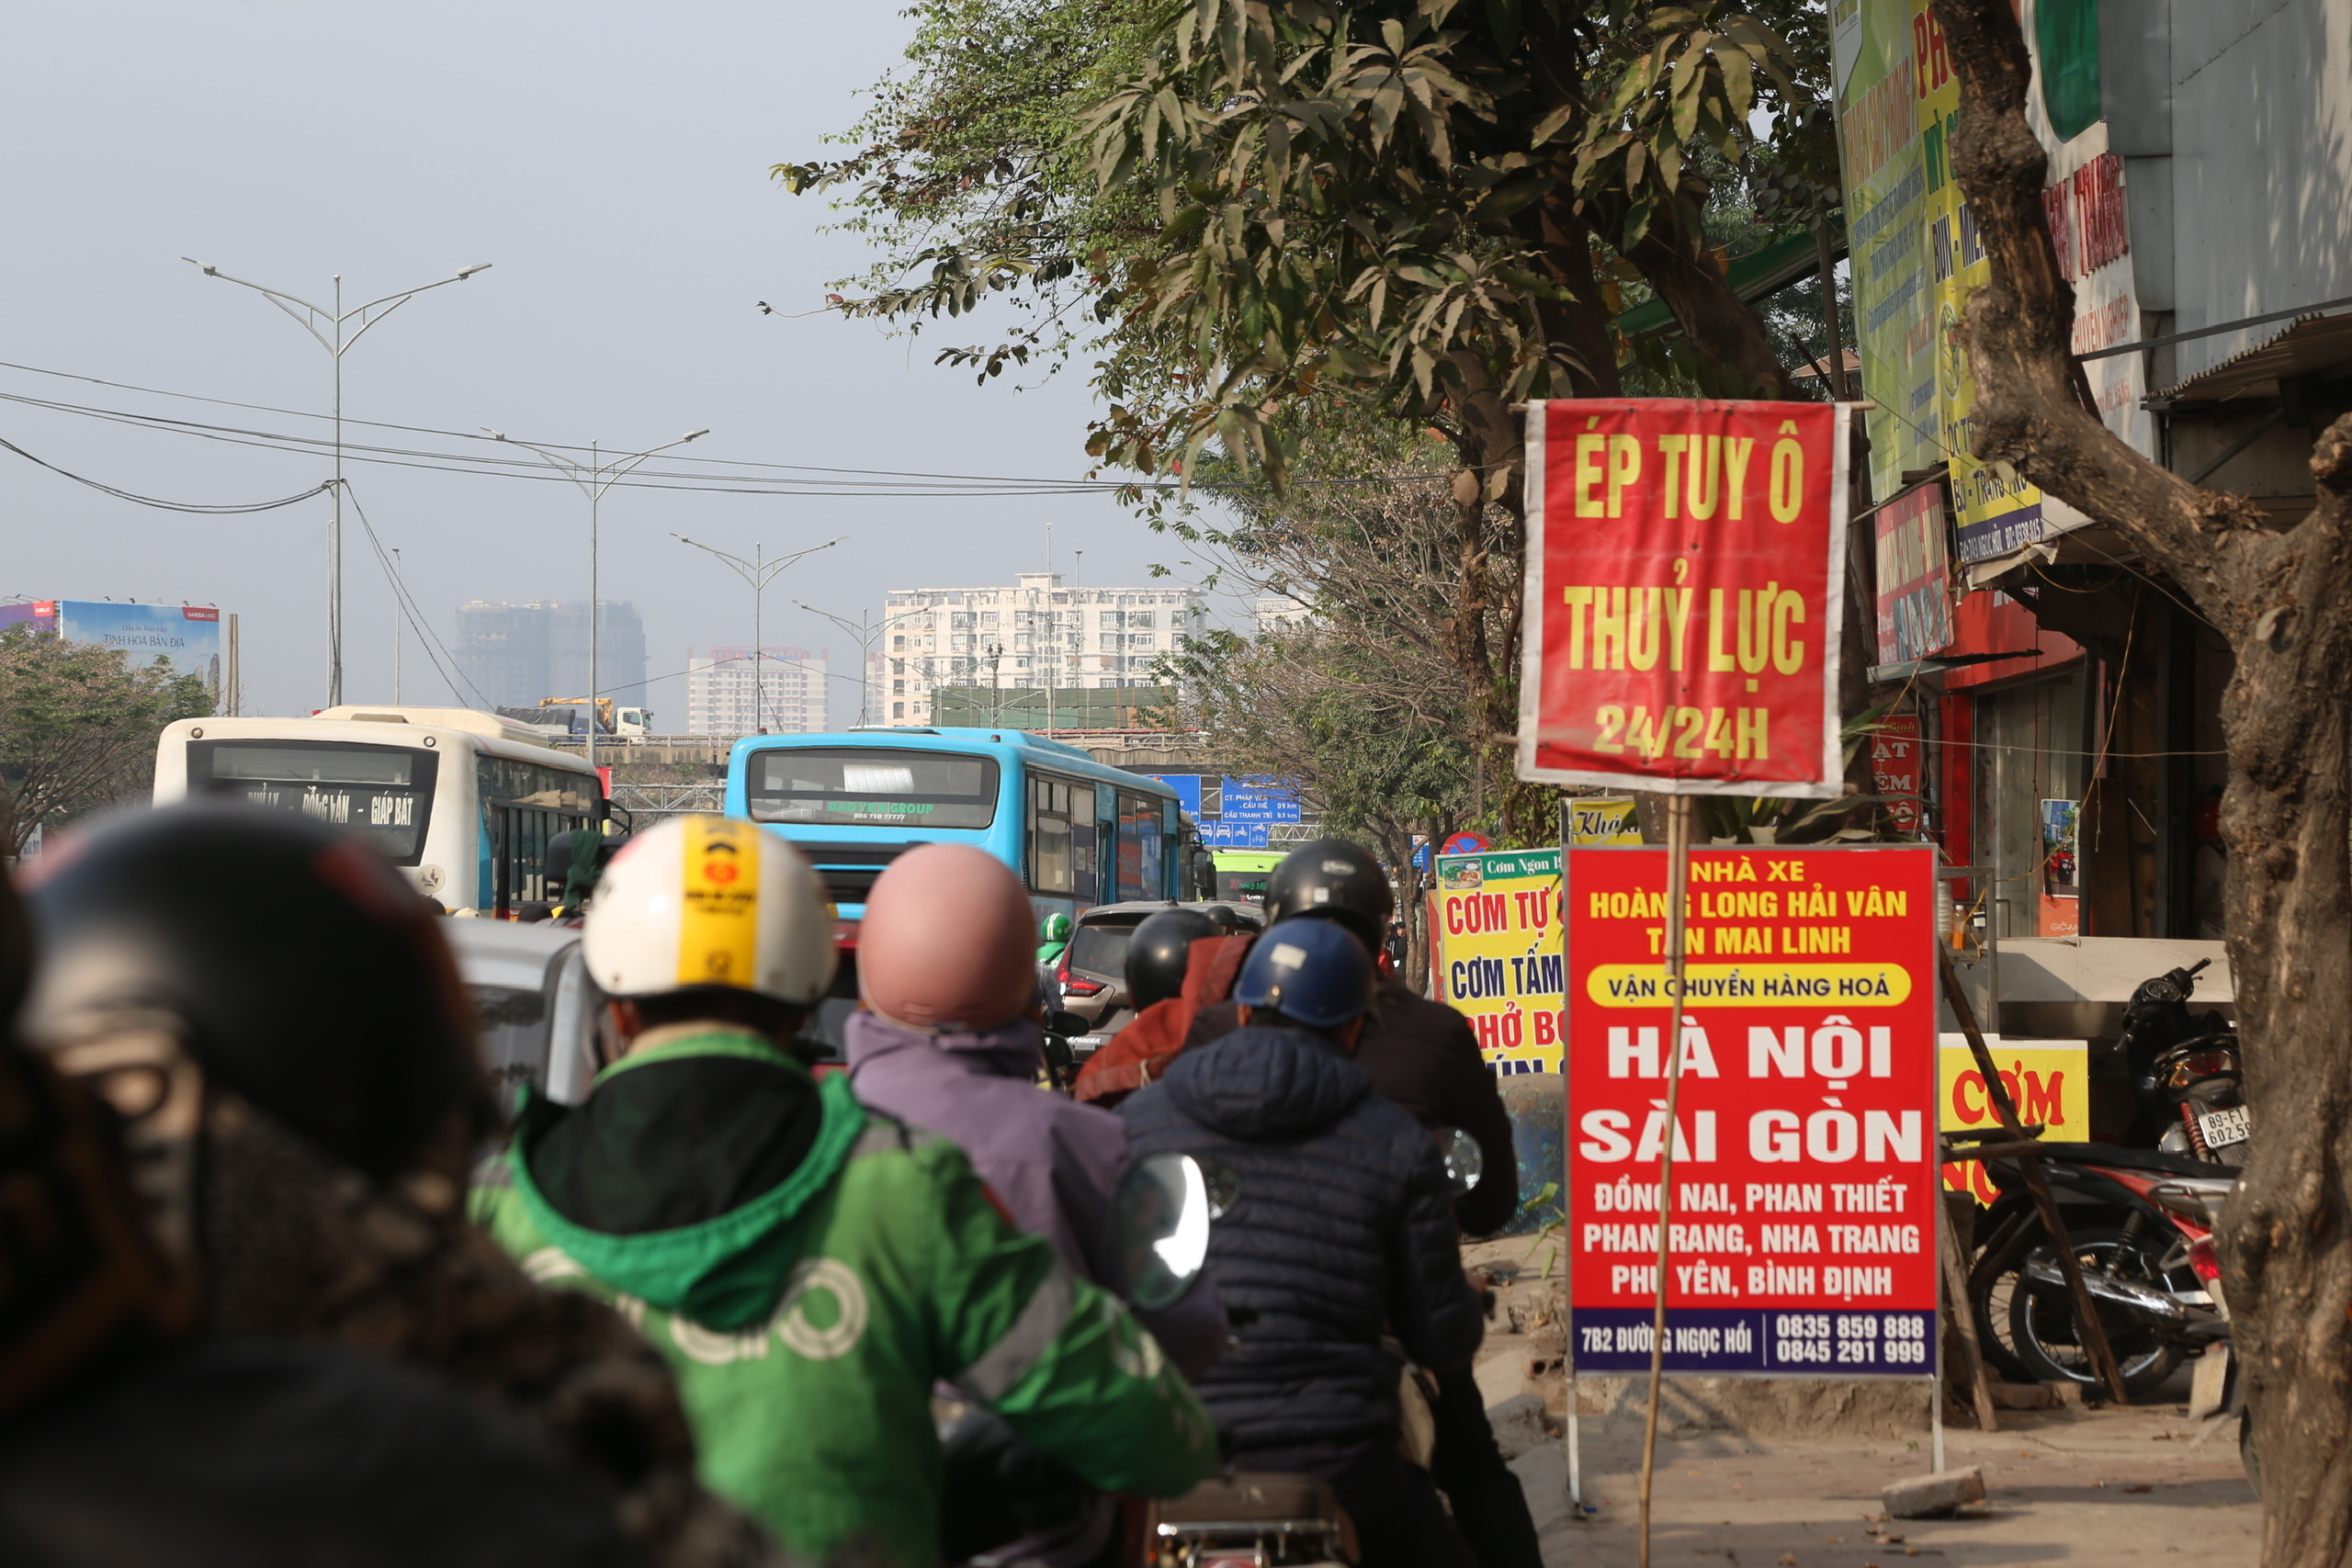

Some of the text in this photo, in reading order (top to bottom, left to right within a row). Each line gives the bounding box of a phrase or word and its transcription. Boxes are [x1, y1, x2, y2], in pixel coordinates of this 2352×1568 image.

[1931, 204, 1953, 285] BÚN
[2072, 303, 2102, 355] HUYÊN
[1575, 416, 1804, 524] ÉP TUY Ô
[129, 636, 146, 646] HOA
[1564, 558, 1692, 671] THUỶ
[1708, 581, 1805, 693] LỰC
[1591, 705, 1770, 761] 24/24H
[370, 790, 393, 826] GIÁP
[394, 793, 413, 826] BÁT
[890, 803, 934, 814] GROUP
[1486, 858, 1515, 874] Cơm
[1519, 858, 1551, 876] Ngon
[1691, 856, 1804, 882] NHÀ XE
[1445, 889, 1508, 935] CƠM
[1514, 886, 1552, 938] TỰ
[1701, 890, 1778, 918] LONG
[1788, 883, 1838, 918] HẢI
[1846, 886, 1907, 917] VÂN
[1646, 926, 1851, 954] TN MAI LINH
[1451, 942, 1565, 1000] CƠM TẤM
[1609, 968, 1891, 1002] VẬN CHUYỂN HÀNG HOÁ
[1487, 1054, 1544, 1077] ÚN
[1608, 1015, 1892, 1089] HÀ NỘI
[1951, 1060, 2065, 1126] CƠM
[1579, 1097, 1922, 1163] SÀI GÒN
[2208, 1109, 2244, 1129] 89-F1
[1679, 1183, 1738, 1215] NAI,
[1747, 1183, 1823, 1213] PHAN
[1831, 1176, 1907, 1213] THIẾT
[1583, 1224, 1920, 1257] PHAN RANG, NHA TRANG
[1676, 1259, 1739, 1298] YÊN,
[1747, 1259, 1815, 1295] BÌNH
[1824, 1266, 1893, 1303] ĐỊNH
[1581, 1327, 1613, 1352] 7B2
[1676, 1327, 1721, 1359] NGỌC
[1724, 1319, 1753, 1353] HỒI
[1776, 1314, 1925, 1340] 0835 859 888
[1776, 1340, 1926, 1363] 0845 291 999
